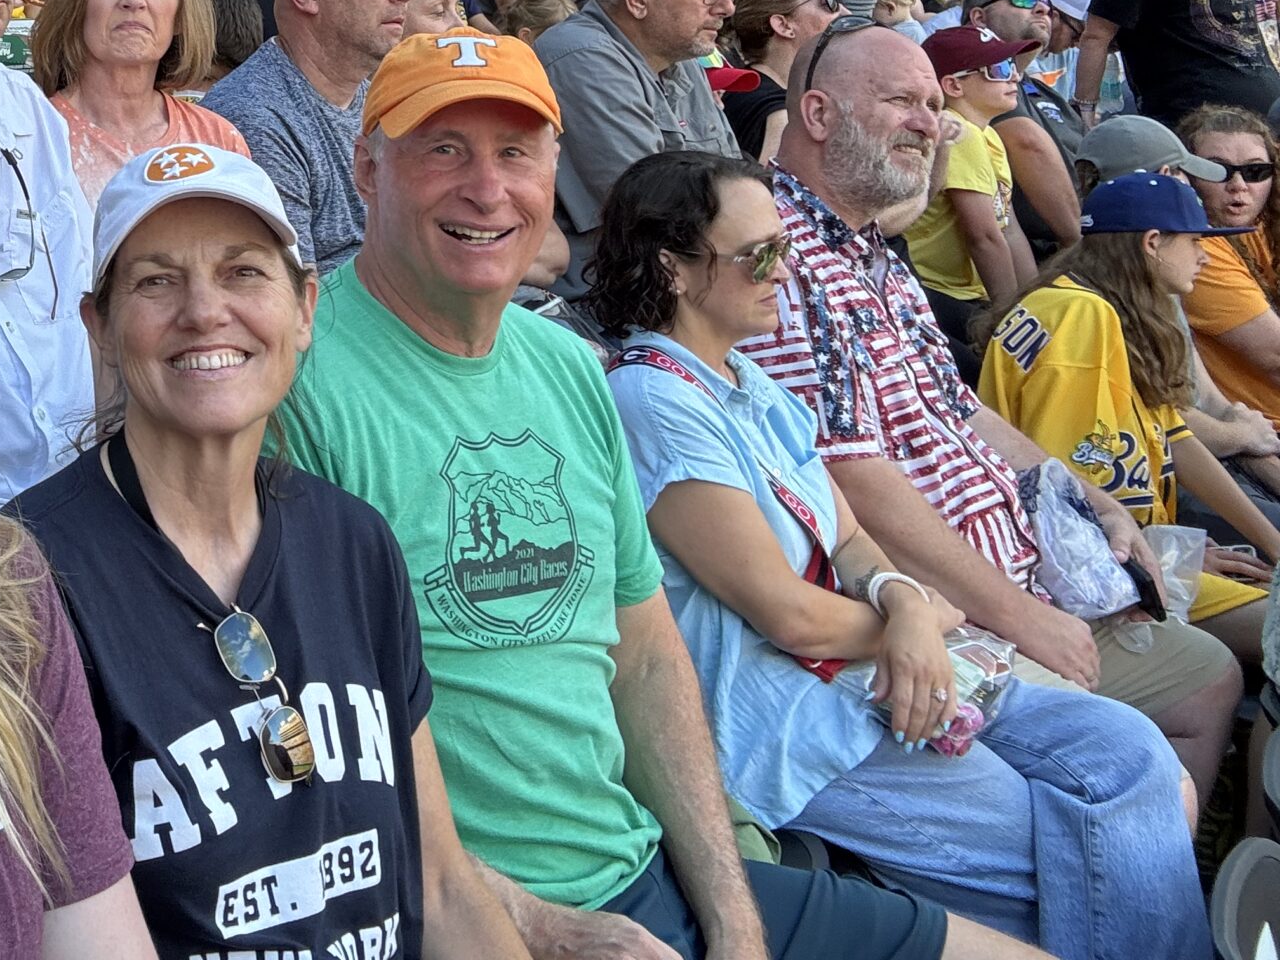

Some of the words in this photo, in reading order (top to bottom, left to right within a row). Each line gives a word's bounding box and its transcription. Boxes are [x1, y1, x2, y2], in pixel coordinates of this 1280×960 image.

[436, 36, 497, 67] T
[656, 355, 687, 378] GO
[785, 491, 812, 521] GO
[515, 547, 535, 560] 2021
[463, 568, 519, 593] Washington
[520, 563, 539, 586] City
[540, 558, 568, 581] Races
[436, 592, 498, 647] WASHINGTON
[554, 608, 569, 631] LIKE
[566, 573, 588, 611] HOME
[222, 874, 299, 928] EST.
[319, 839, 377, 891] 892
